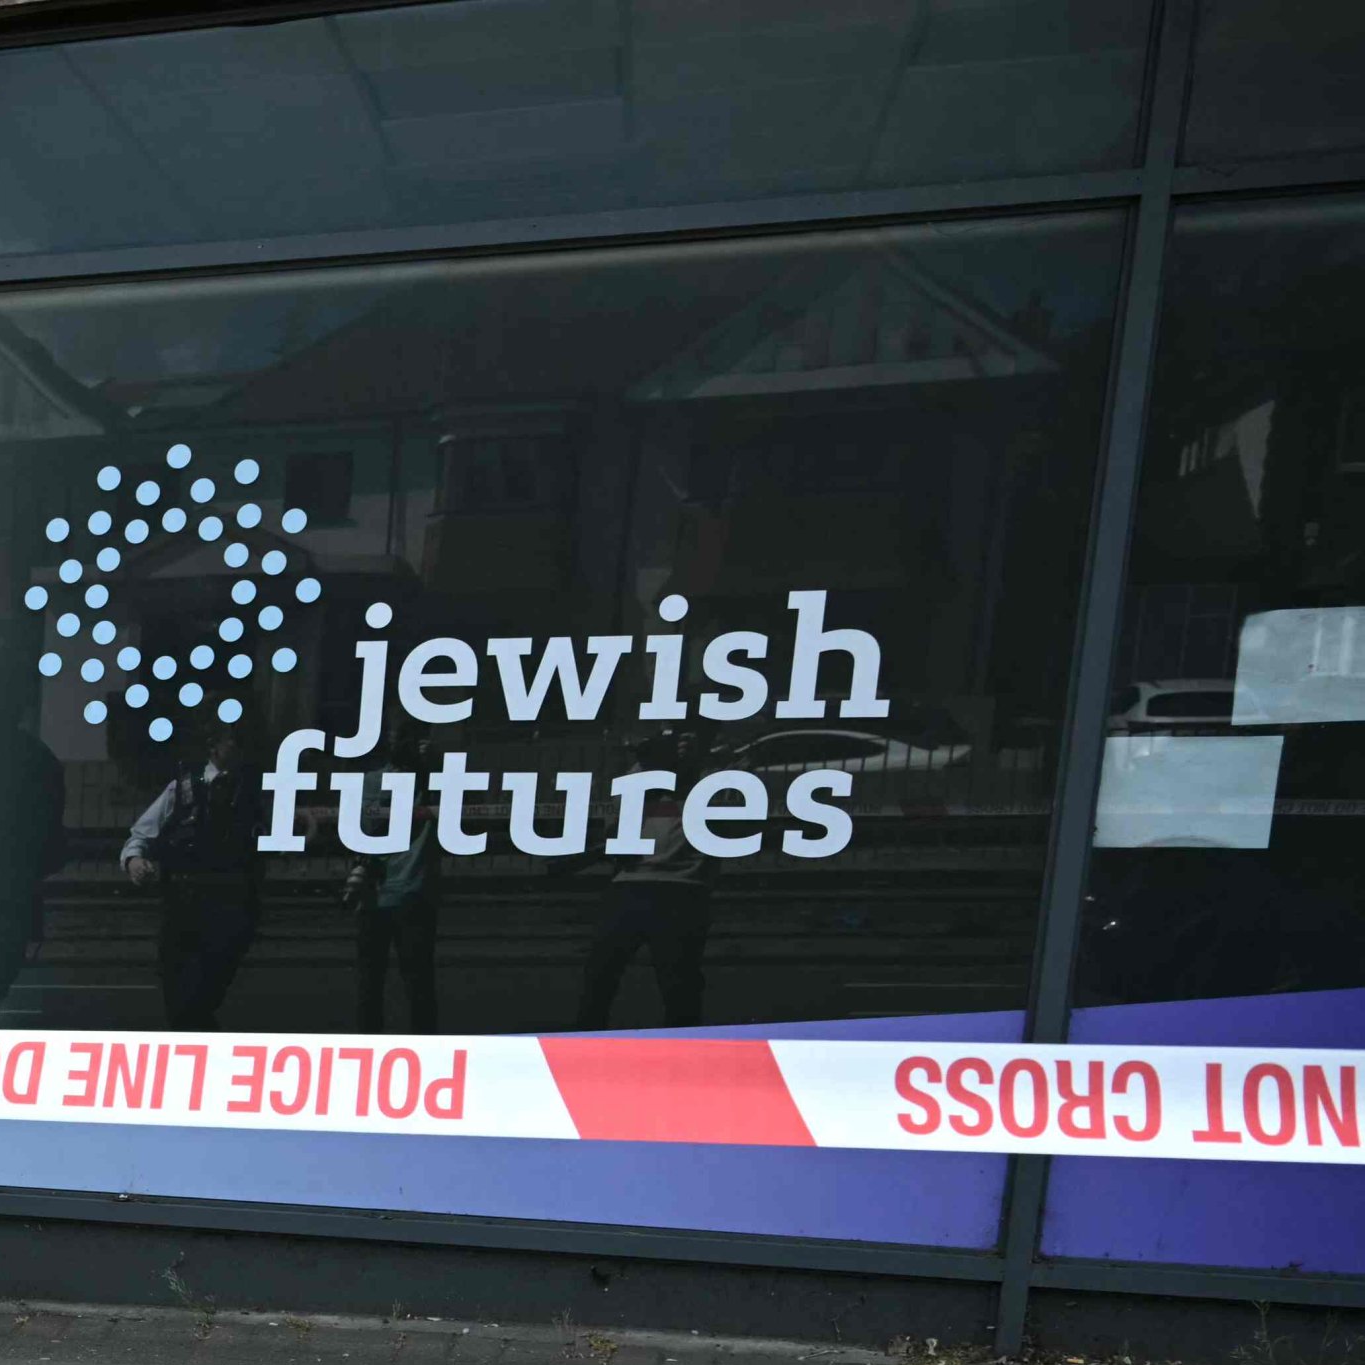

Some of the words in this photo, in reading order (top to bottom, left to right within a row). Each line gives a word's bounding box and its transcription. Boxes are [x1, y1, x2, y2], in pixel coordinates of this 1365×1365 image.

[335, 589, 891, 759] jewish
[257, 728, 855, 859] futures
[62, 1042, 209, 1112] LINE
[226, 1045, 468, 1120] POLICE
[894, 1055, 1163, 1142] CROSS
[1191, 1062, 1362, 1147] NOT
